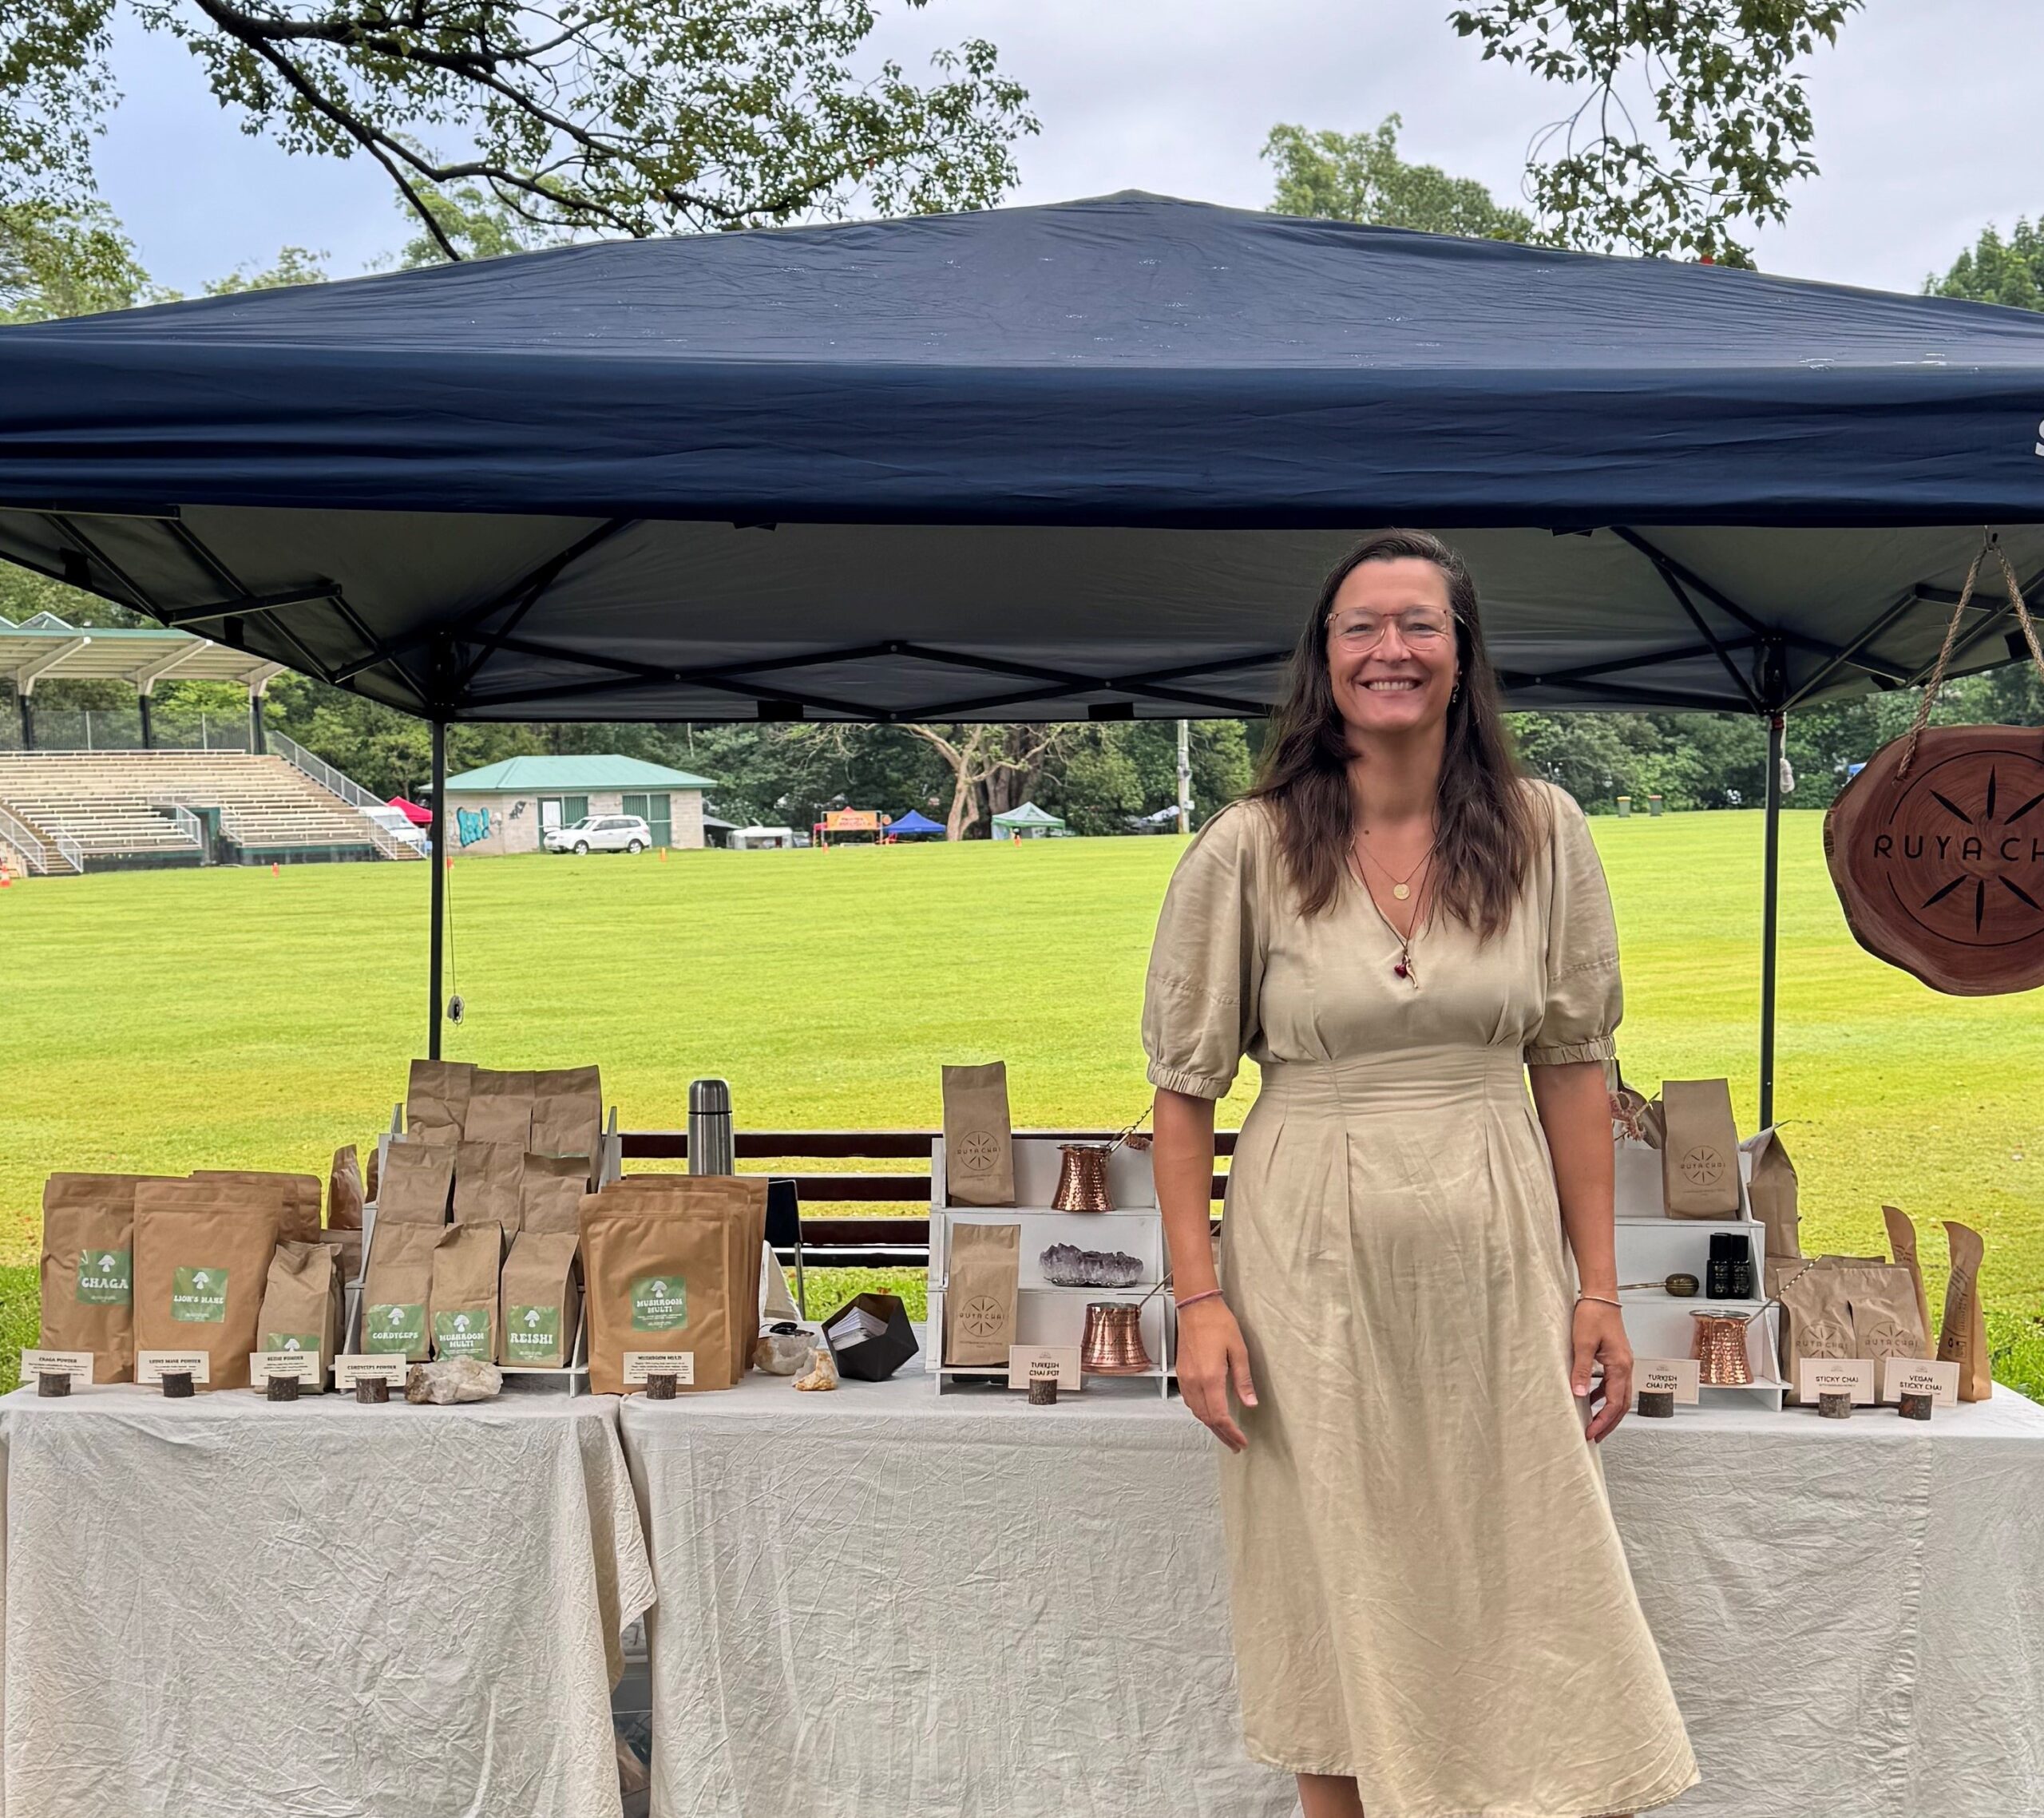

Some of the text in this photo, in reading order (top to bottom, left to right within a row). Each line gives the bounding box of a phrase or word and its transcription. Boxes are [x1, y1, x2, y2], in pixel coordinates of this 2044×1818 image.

[1874, 834, 1983, 861] RUYA
[81, 1277, 129, 1289] CHAGA
[636, 1298, 683, 1307] MUSHROOM
[648, 1305, 672, 1314] MULTI
[510, 1333, 553, 1345] REISHI
